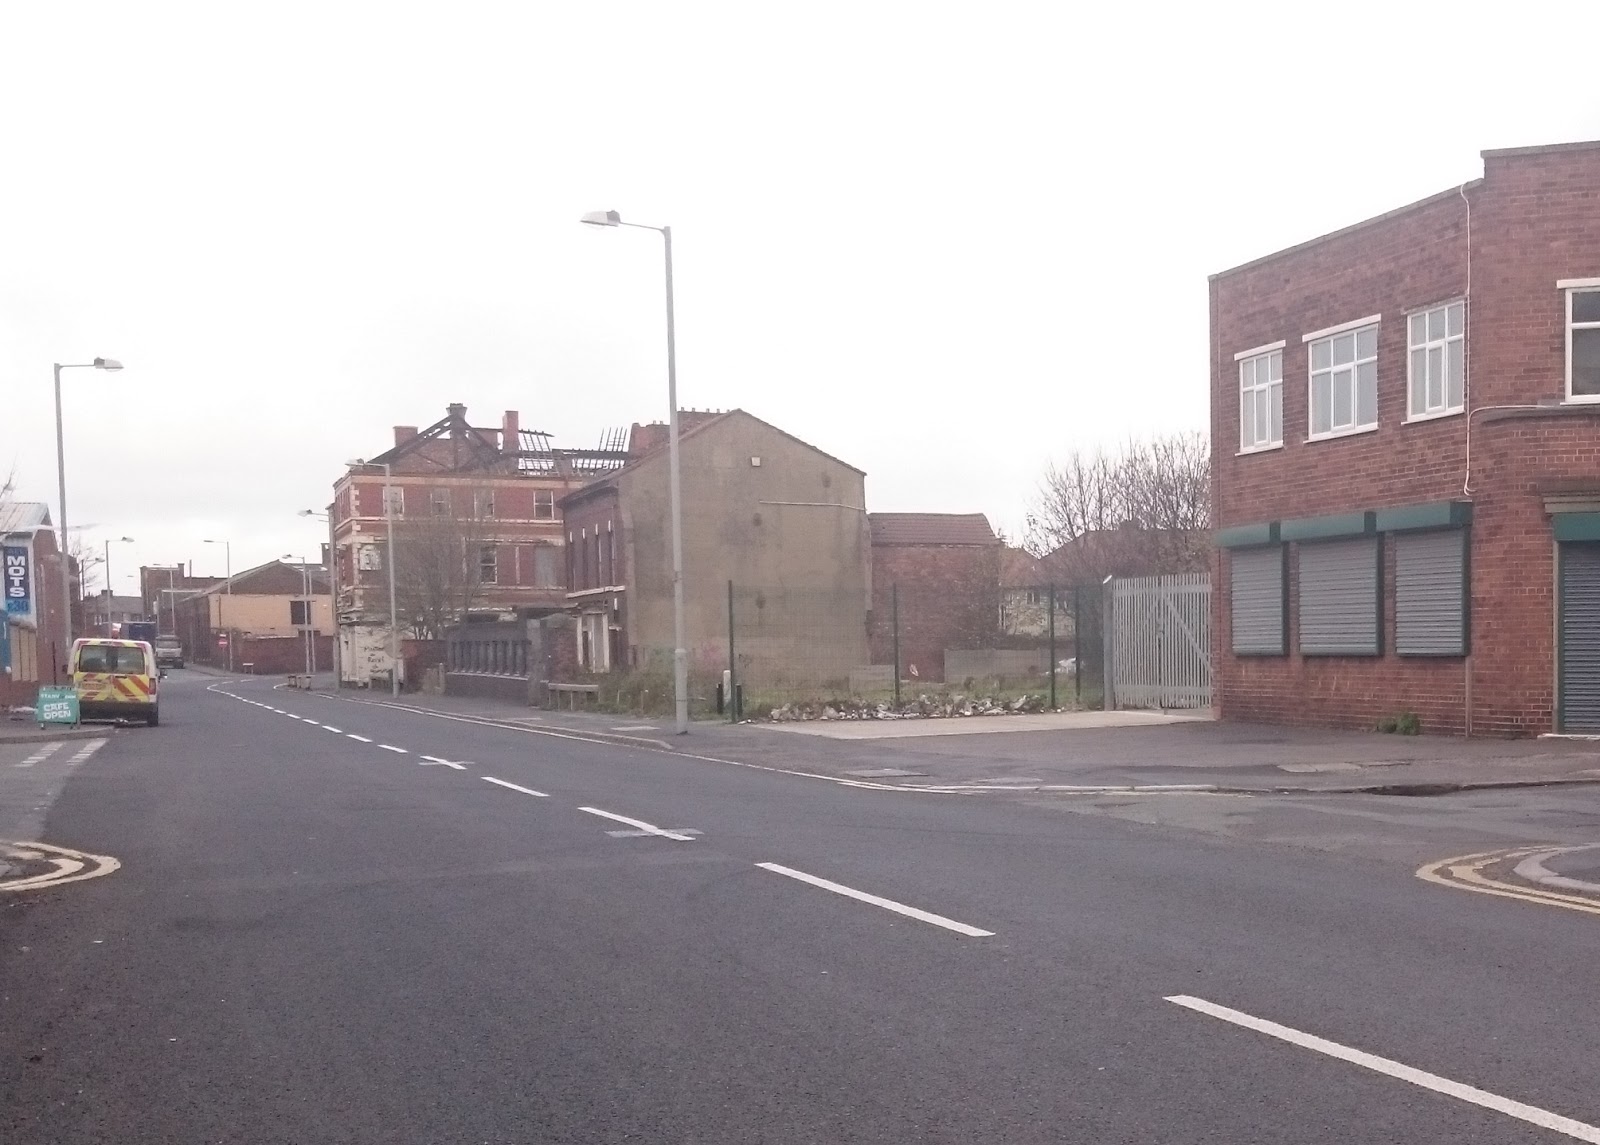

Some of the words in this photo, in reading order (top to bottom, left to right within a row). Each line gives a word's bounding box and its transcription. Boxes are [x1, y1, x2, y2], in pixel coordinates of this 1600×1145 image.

[7, 555, 25, 598] MOTS
[44, 702, 69, 711] CAFE
[44, 710, 71, 719] OPEN
